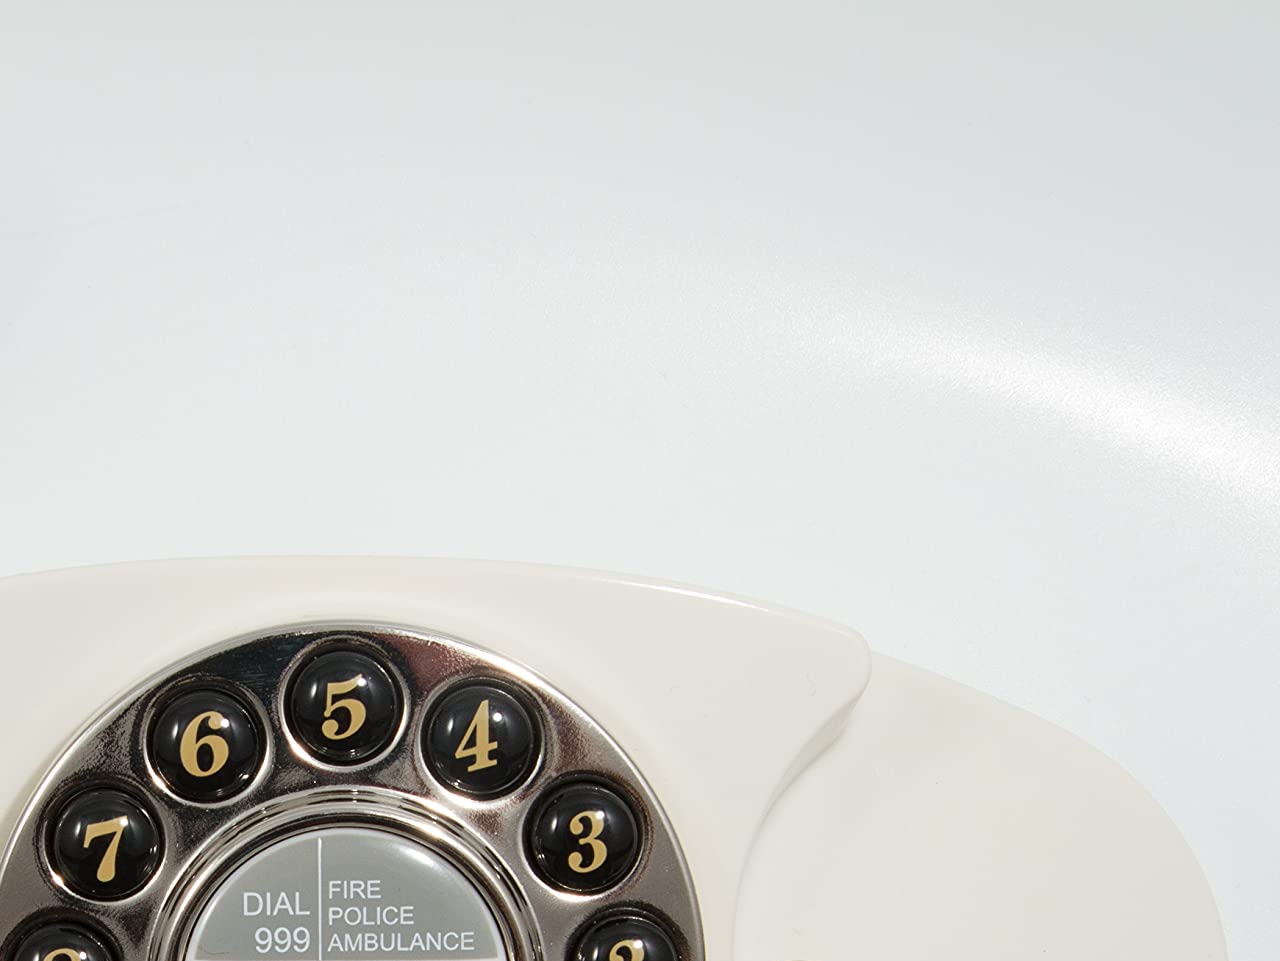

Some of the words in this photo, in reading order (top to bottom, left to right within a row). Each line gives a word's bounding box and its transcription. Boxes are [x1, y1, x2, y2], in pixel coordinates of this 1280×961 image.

[322, 675, 366, 740] 5
[179, 710, 230, 777] 6
[455, 701, 498, 772] 4
[82, 818, 126, 882] 7
[567, 810, 607, 873] 3
[243, 891, 311, 917] DIAL
[328, 879, 382, 900] FIRE
[328, 905, 415, 926] POLICE
[254, 925, 311, 954] 999
[327, 931, 475, 952] AMBULANCE
